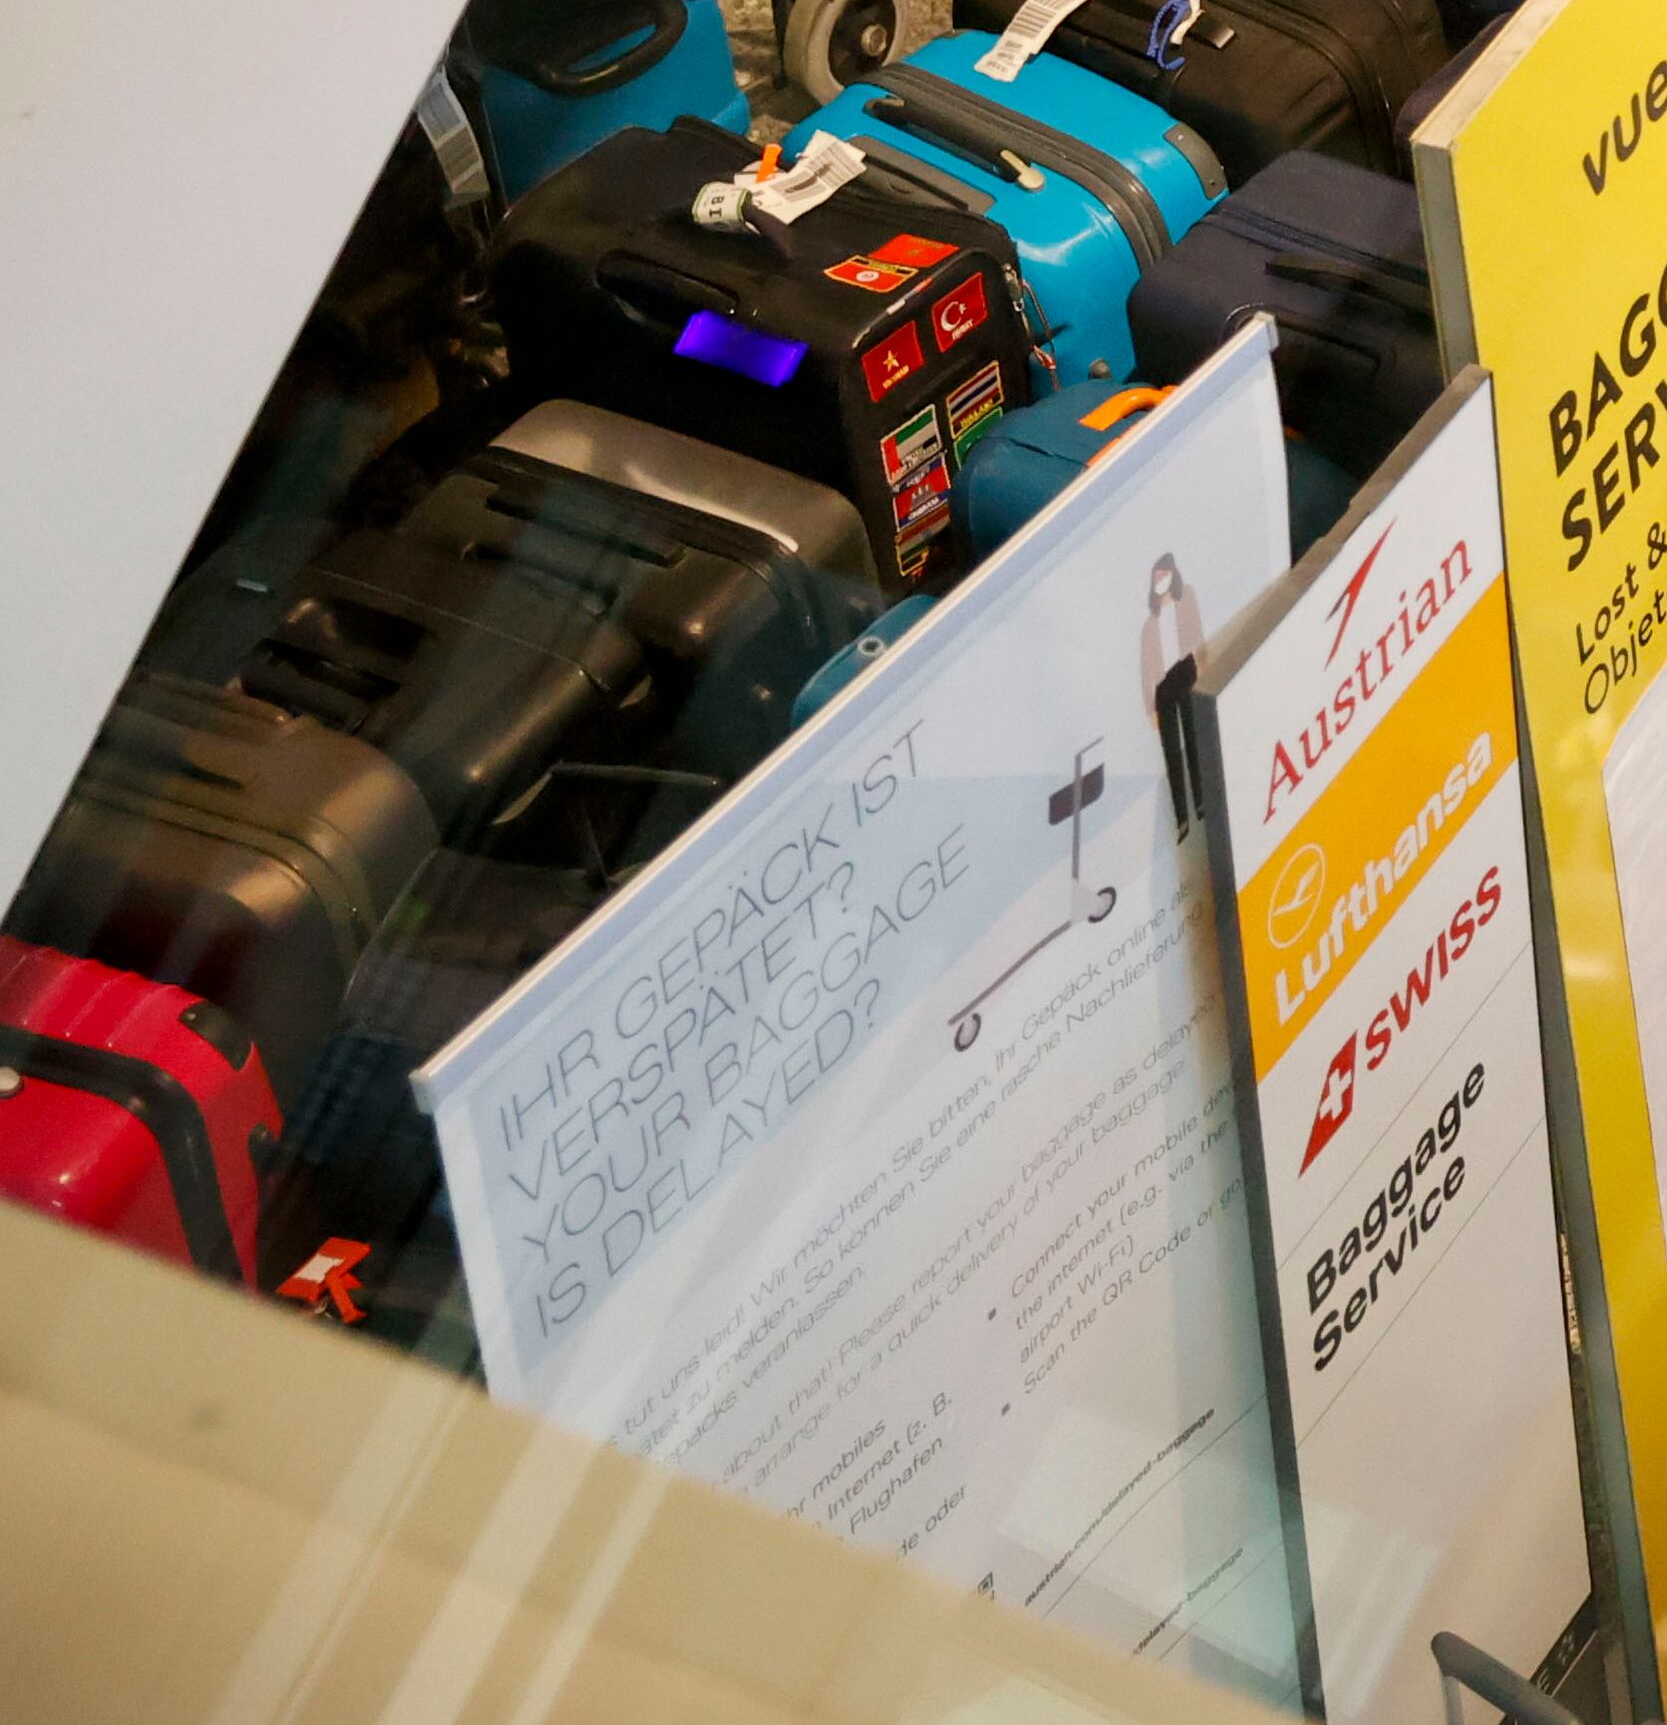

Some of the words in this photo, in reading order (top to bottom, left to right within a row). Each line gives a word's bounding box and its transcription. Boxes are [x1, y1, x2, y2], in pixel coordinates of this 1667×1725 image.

[1263, 538, 1473, 826] Austrian
[1575, 564, 1639, 664] Lost
[1646, 521, 1667, 570] &
[499, 1028, 599, 1151] IHR
[614, 805, 838, 1039] GEPÄCK
[851, 719, 923, 826] IST
[1275, 731, 1494, 1027] Lufthansa
[1365, 866, 1502, 1071] SWISS
[509, 861, 854, 1199] VERSPÄTET?
[522, 1090, 691, 1262] YOUR
[704, 825, 967, 1105] BAGGAGE
[535, 1261, 587, 1338] IS
[601, 978, 880, 1276] DELAYED?
[1010, 1212, 1081, 1298] Connect
[1086, 1174, 1125, 1219] your
[1133, 1115, 1197, 1176] mobile
[1014, 1294, 1043, 1330] the
[1047, 1219, 1112, 1295] internet
[1118, 1184, 1162, 1226] (e.g.
[1167, 1153, 1195, 1182] via
[1199, 1119, 1227, 1154] the
[1309, 1063, 1484, 1315] Baggage
[1313, 1154, 1466, 1371] Service
[1019, 1295, 1073, 1364] airport
[1076, 1233, 1134, 1295] Wi-Fi)
[1023, 1342, 1065, 1394] Scan
[1069, 1306, 1097, 1342] the
[1101, 1269, 1133, 1306] QR
[1137, 1225, 1191, 1274] Code
[1195, 1205, 1213, 1227] or
[1218, 1177, 1240, 1210] go
[811, 1420, 885, 1499] mobiles
[827, 1439, 900, 1520] Internet
[849, 1437, 943, 1534] Flughafen
[924, 1485, 965, 1533] oder
